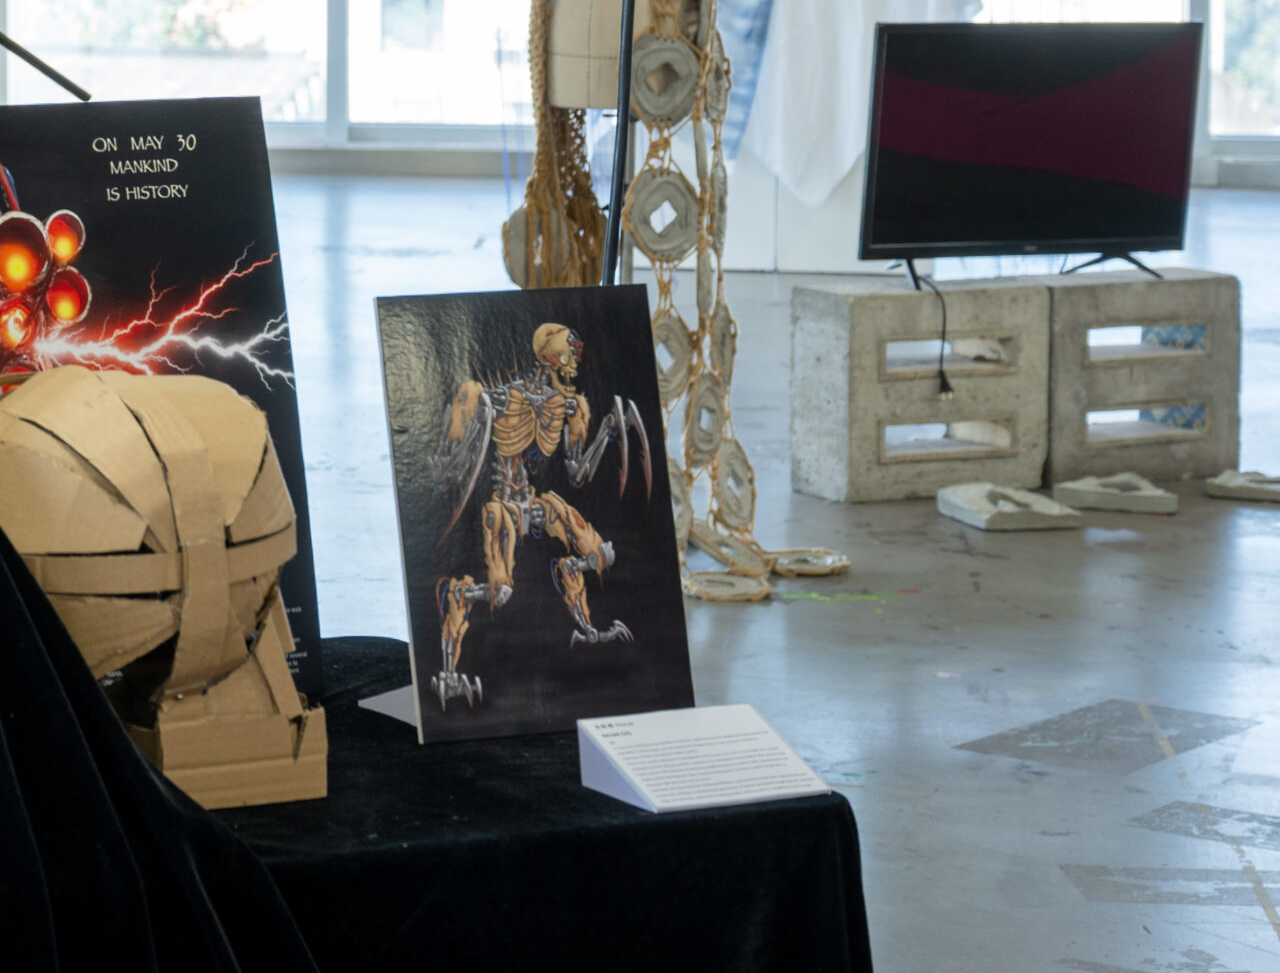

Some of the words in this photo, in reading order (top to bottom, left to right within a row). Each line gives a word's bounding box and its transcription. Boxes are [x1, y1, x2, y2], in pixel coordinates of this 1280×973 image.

[92, 136, 118, 152] ON
[130, 135, 164, 151] MAY
[176, 133, 197, 151] 30
[109, 158, 179, 174] MANKIND
[106, 186, 120, 201] IS
[125, 184, 189, 201] HISTORY
